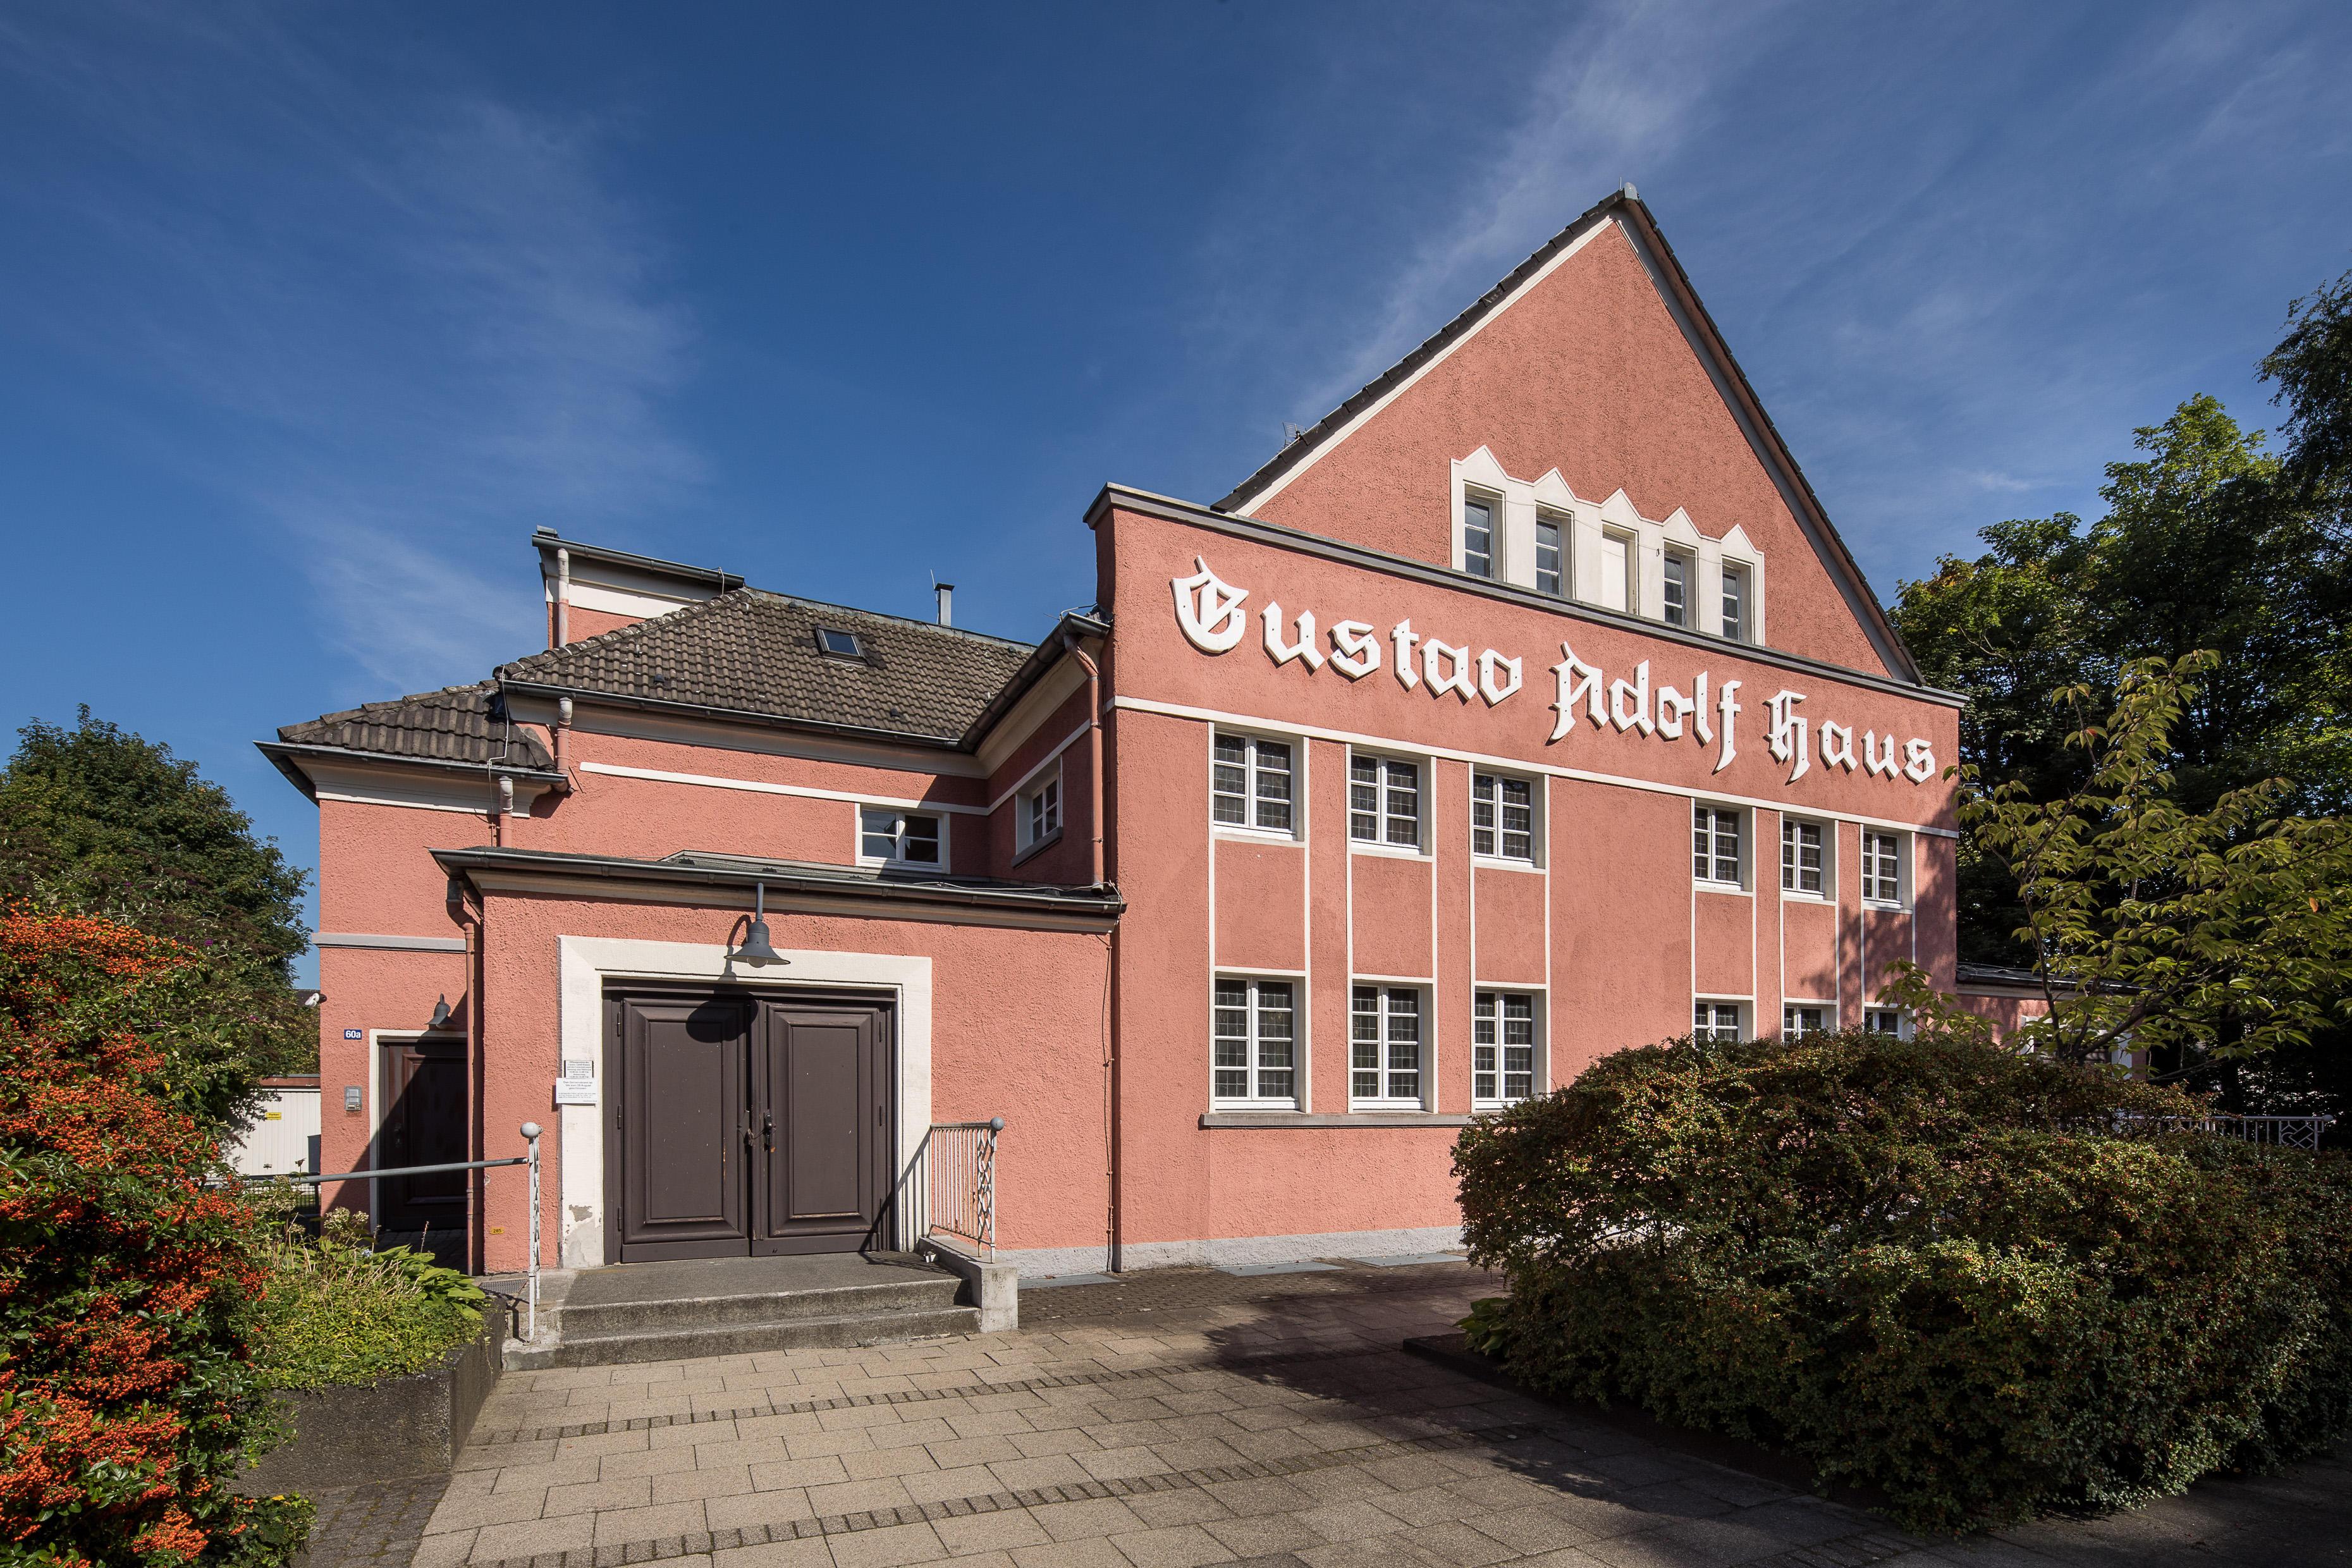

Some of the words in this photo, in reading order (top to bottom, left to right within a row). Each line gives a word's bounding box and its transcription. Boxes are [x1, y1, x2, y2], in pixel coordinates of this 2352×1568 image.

[1170, 554, 1522, 706] Gustav
[1550, 640, 1743, 774] Adolf
[1764, 688, 1937, 785] Haus
[345, 1030, 361, 1038] 60a
